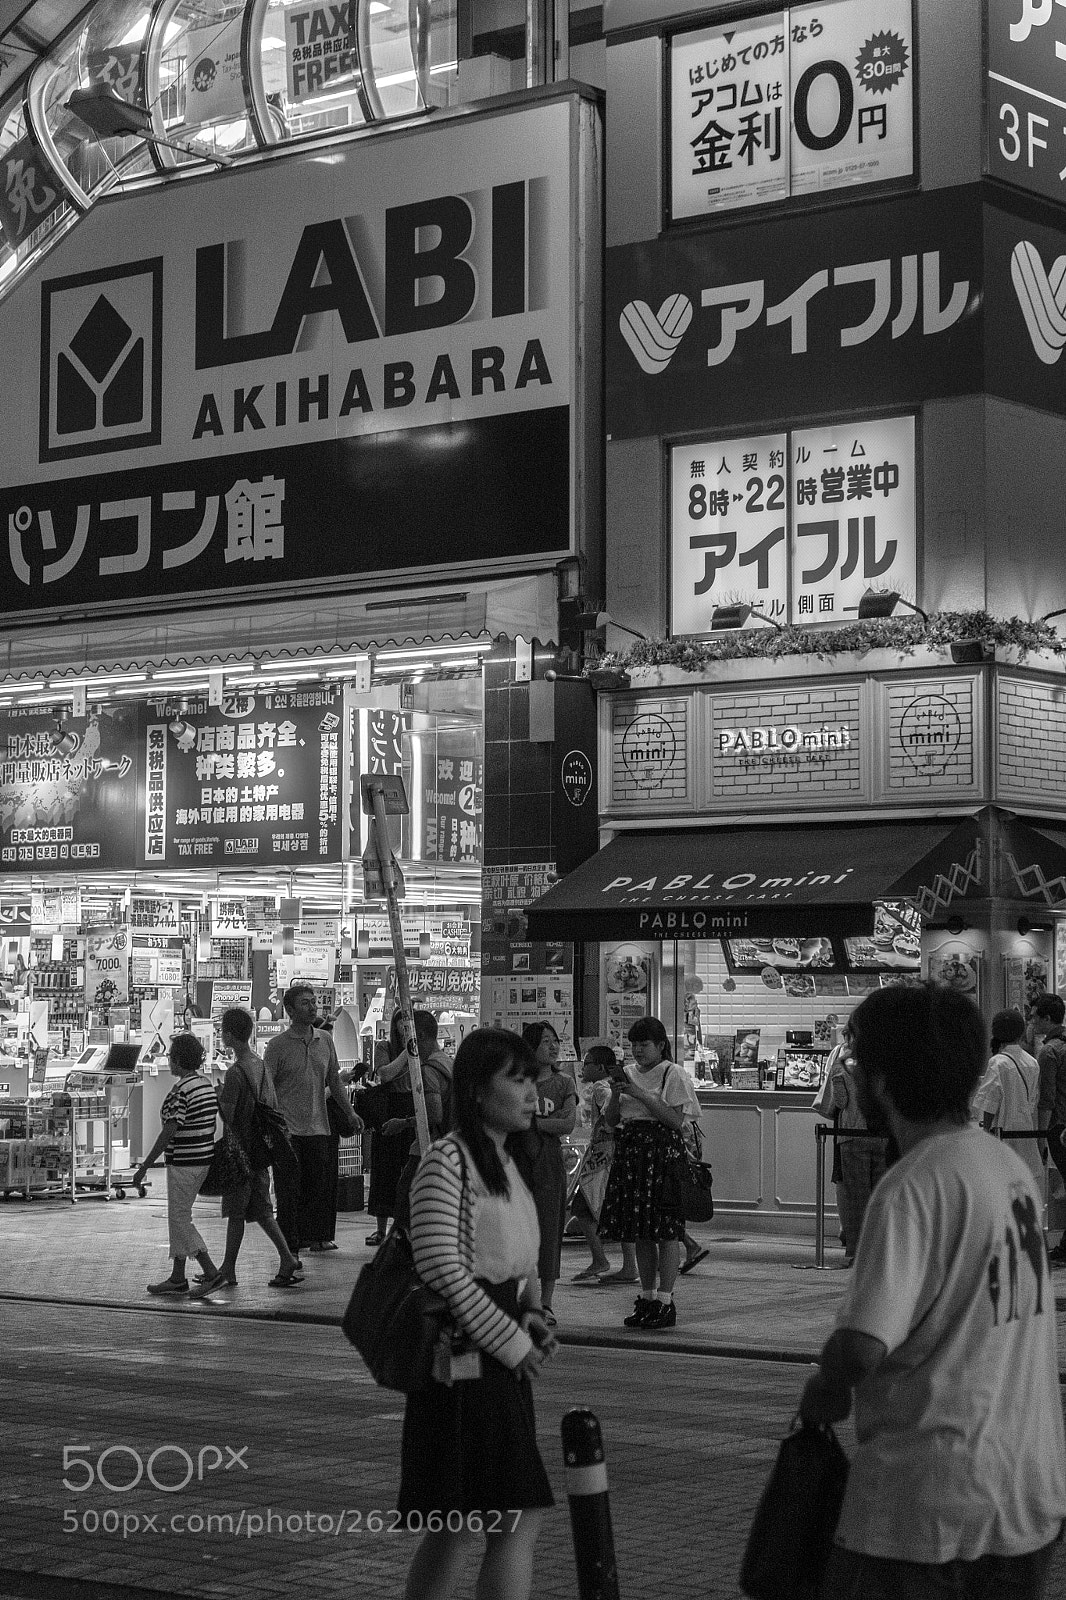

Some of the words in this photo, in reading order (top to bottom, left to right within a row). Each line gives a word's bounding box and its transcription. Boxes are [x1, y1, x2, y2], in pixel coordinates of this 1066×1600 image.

[291, 2, 350, 46] TAX
[224, 52, 240, 62] Japa
[689, 18, 824, 85] はじめての方なら
[863, 62, 902, 80] 30日間
[691, 79, 783, 118] アコムは
[689, 105, 783, 176] 金利
[793, 59, 888, 151] 0円
[998, 103, 1049, 168] 3F
[195, 179, 531, 370] LABI
[701, 250, 969, 367] アイフル
[192, 338, 553, 440] AKIHABARA
[688, 482, 729, 521] 8時
[745, 461, 899, 514] 22時営業中
[689, 516, 898, 596] アイフル
[719, 728, 797, 750] PABLO
[802, 726, 848, 747] mini
[909, 724, 950, 744] mini
[195, 750, 285, 781] 种类繁多。
[630, 741, 666, 760] mini
[0, 755, 132, 786] 門量販店ネットワーク
[565, 771, 587, 785] mini
[148, 730, 164, 855] 免税品供应店
[176, 803, 305, 825] 海外可使用的家用电器
[178, 843, 193, 856] TAX
[194, 843, 213, 855] FREE
[235, 838, 259, 849] LABI
[601, 873, 758, 892] PABLO
[759, 868, 855, 888] mini
[639, 911, 707, 929] PABLO
[711, 911, 749, 927] mini
